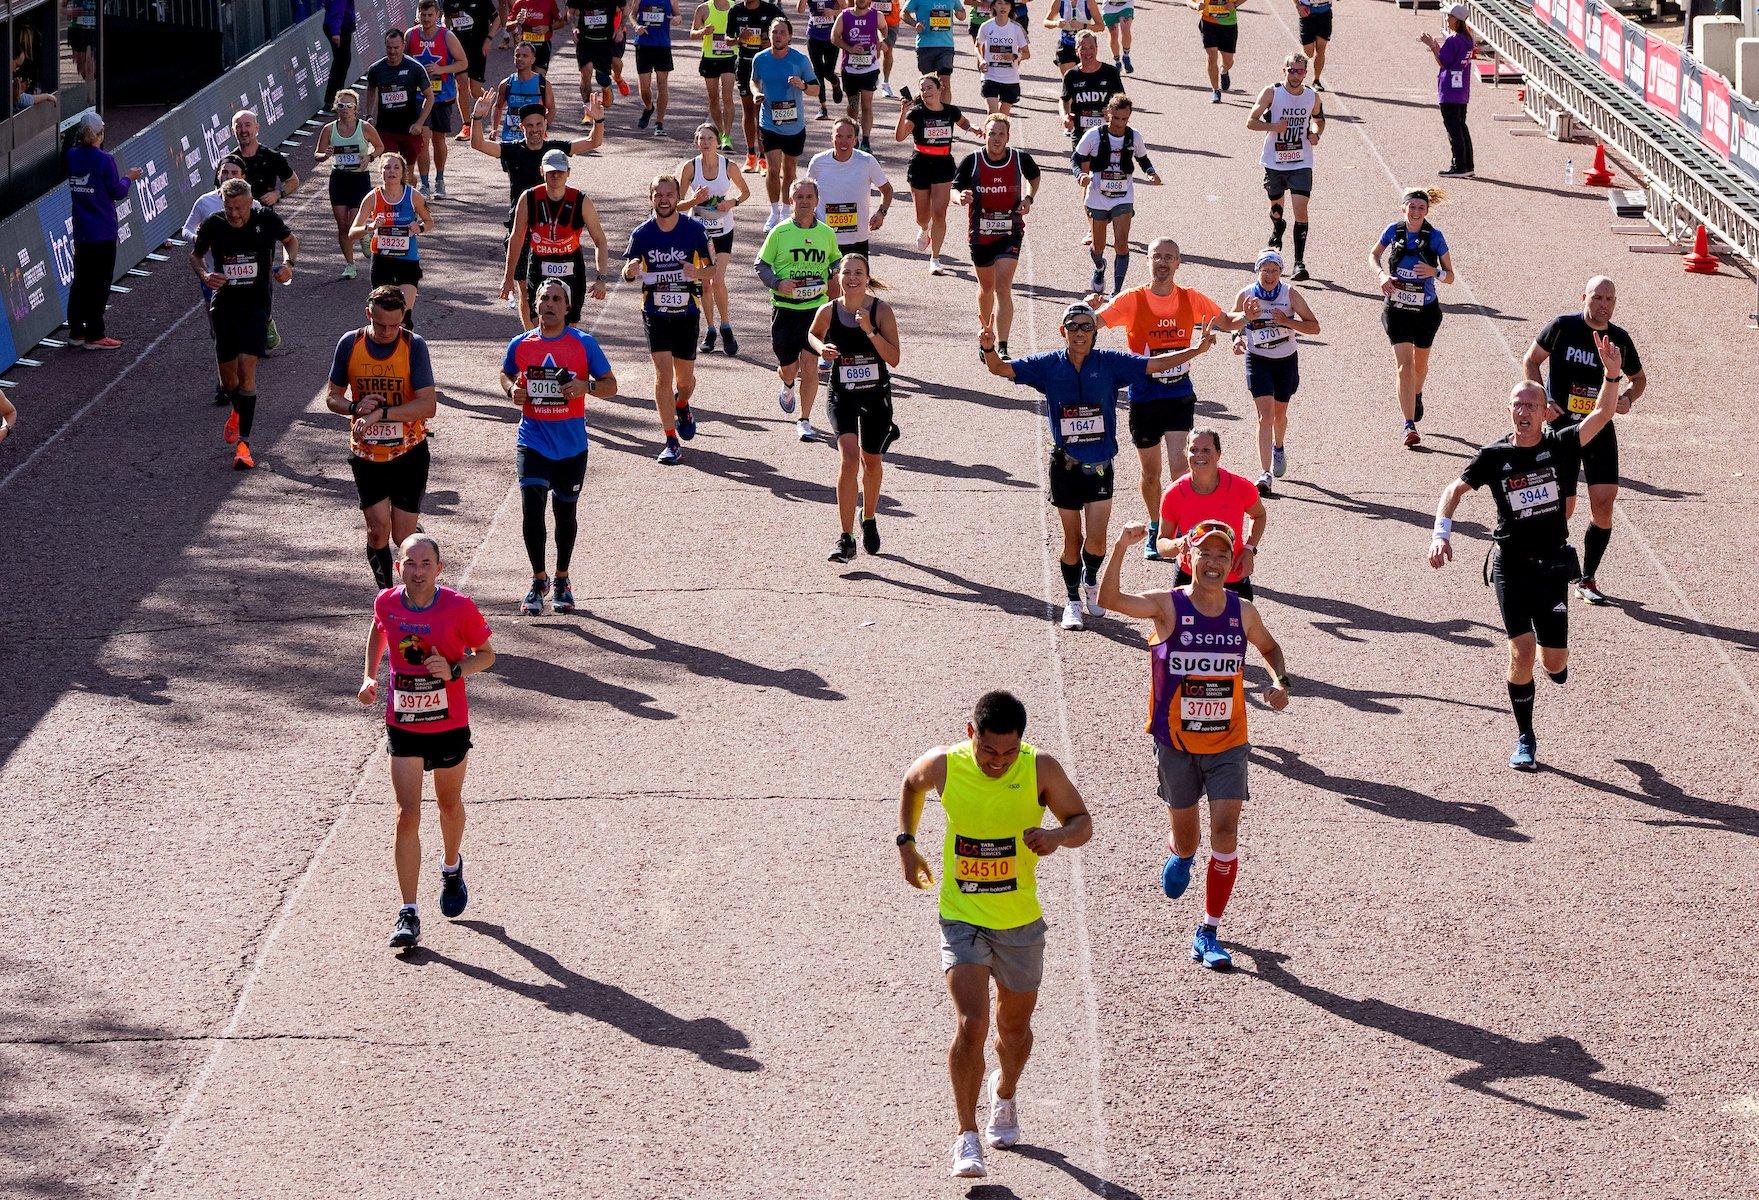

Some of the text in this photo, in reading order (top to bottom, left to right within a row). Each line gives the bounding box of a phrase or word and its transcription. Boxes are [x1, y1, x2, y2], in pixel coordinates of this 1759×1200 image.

[1076, 92, 1108, 103] ANDY
[258, 82, 276, 125] tcs
[135, 176, 157, 224] tcs
[829, 215, 854, 224] 32697
[382, 239, 405, 248] 38232
[537, 244, 572, 254] CHARLIE
[648, 247, 687, 263] Stroke
[790, 248, 826, 264] TYM
[227, 266, 254, 276] 41043
[547, 265, 567, 274] 6092
[660, 295, 682, 304] 5213
[1398, 292, 1416, 302] 4062
[1157, 318, 1176, 328] JON
[1260, 329, 1280, 340] 3701
[1566, 346, 1597, 367] PAUL
[361, 364, 395, 378] TOM
[847, 368, 870, 378] 6896
[357, 378, 402, 391] STREET
[1572, 399, 1596, 410] 3358
[1064, 408, 1078, 417] tcs
[366, 426, 397, 436] 38751
[1070, 420, 1094, 431] 1647
[1510, 478, 1527, 489] tcs
[1520, 487, 1549, 504] 3944
[1542, 506, 1558, 514] balance
[1196, 633, 1242, 645] sense
[1185, 682, 1204, 696] tcs
[401, 693, 440, 708] 39724
[1188, 702, 1227, 716] 37079
[961, 860, 1008, 876] 34510
